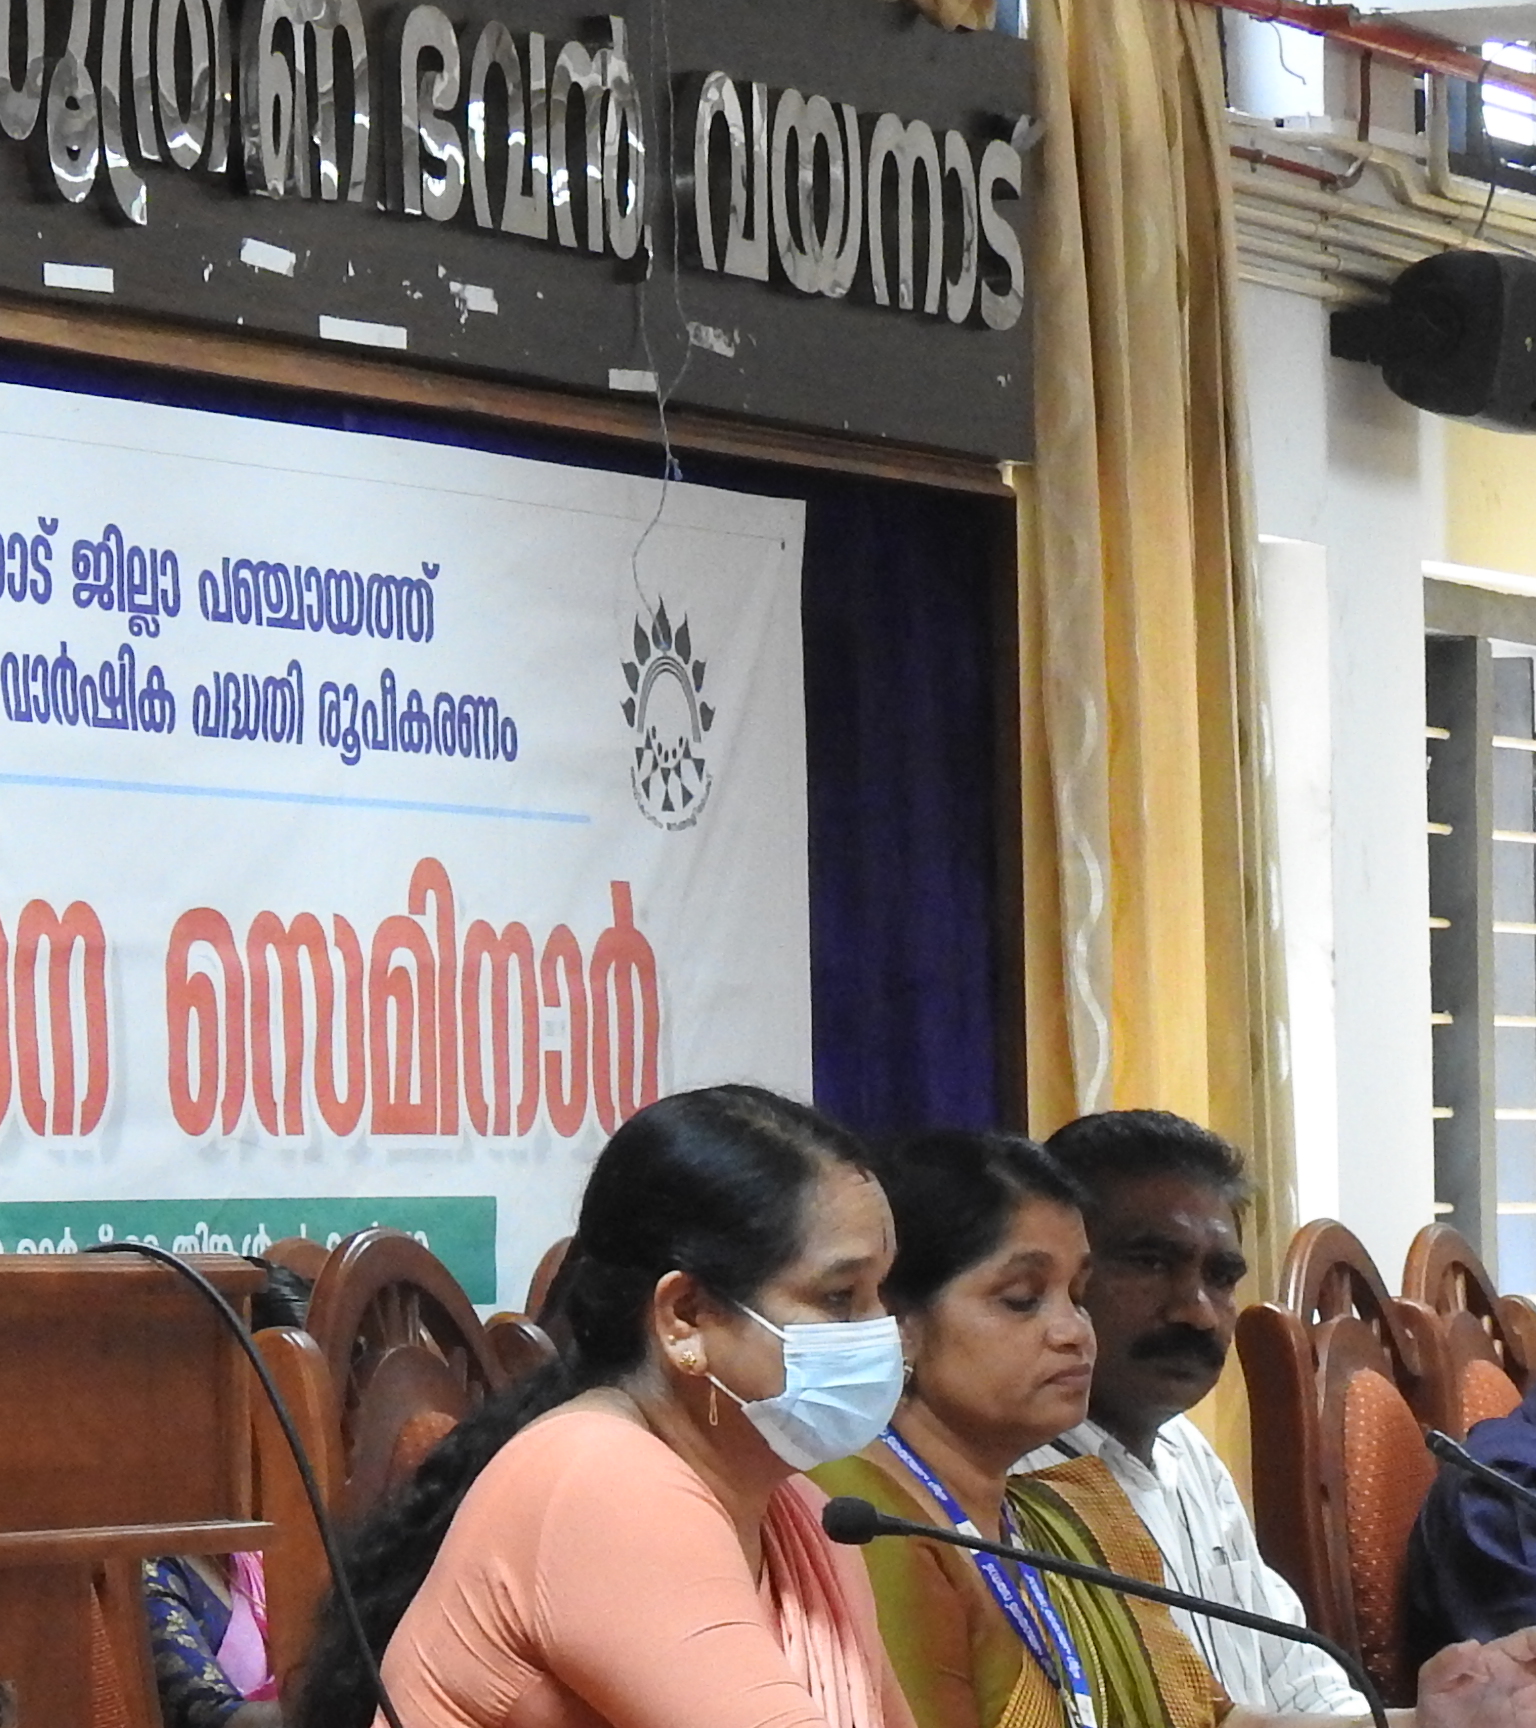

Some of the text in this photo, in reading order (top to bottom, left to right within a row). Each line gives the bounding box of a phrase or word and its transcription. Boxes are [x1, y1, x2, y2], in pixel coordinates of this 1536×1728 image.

[71, 522, 182, 638] ജില്ലാ
[198, 556, 441, 643] പഞ്ചായത്ത്
[0, 641, 177, 735] വാർഷിക
[192, 658, 305, 745] പദ്ധതി
[318, 667, 519, 766] രൂപീകരണം
[166, 857, 660, 1138] സെമിനാർ
